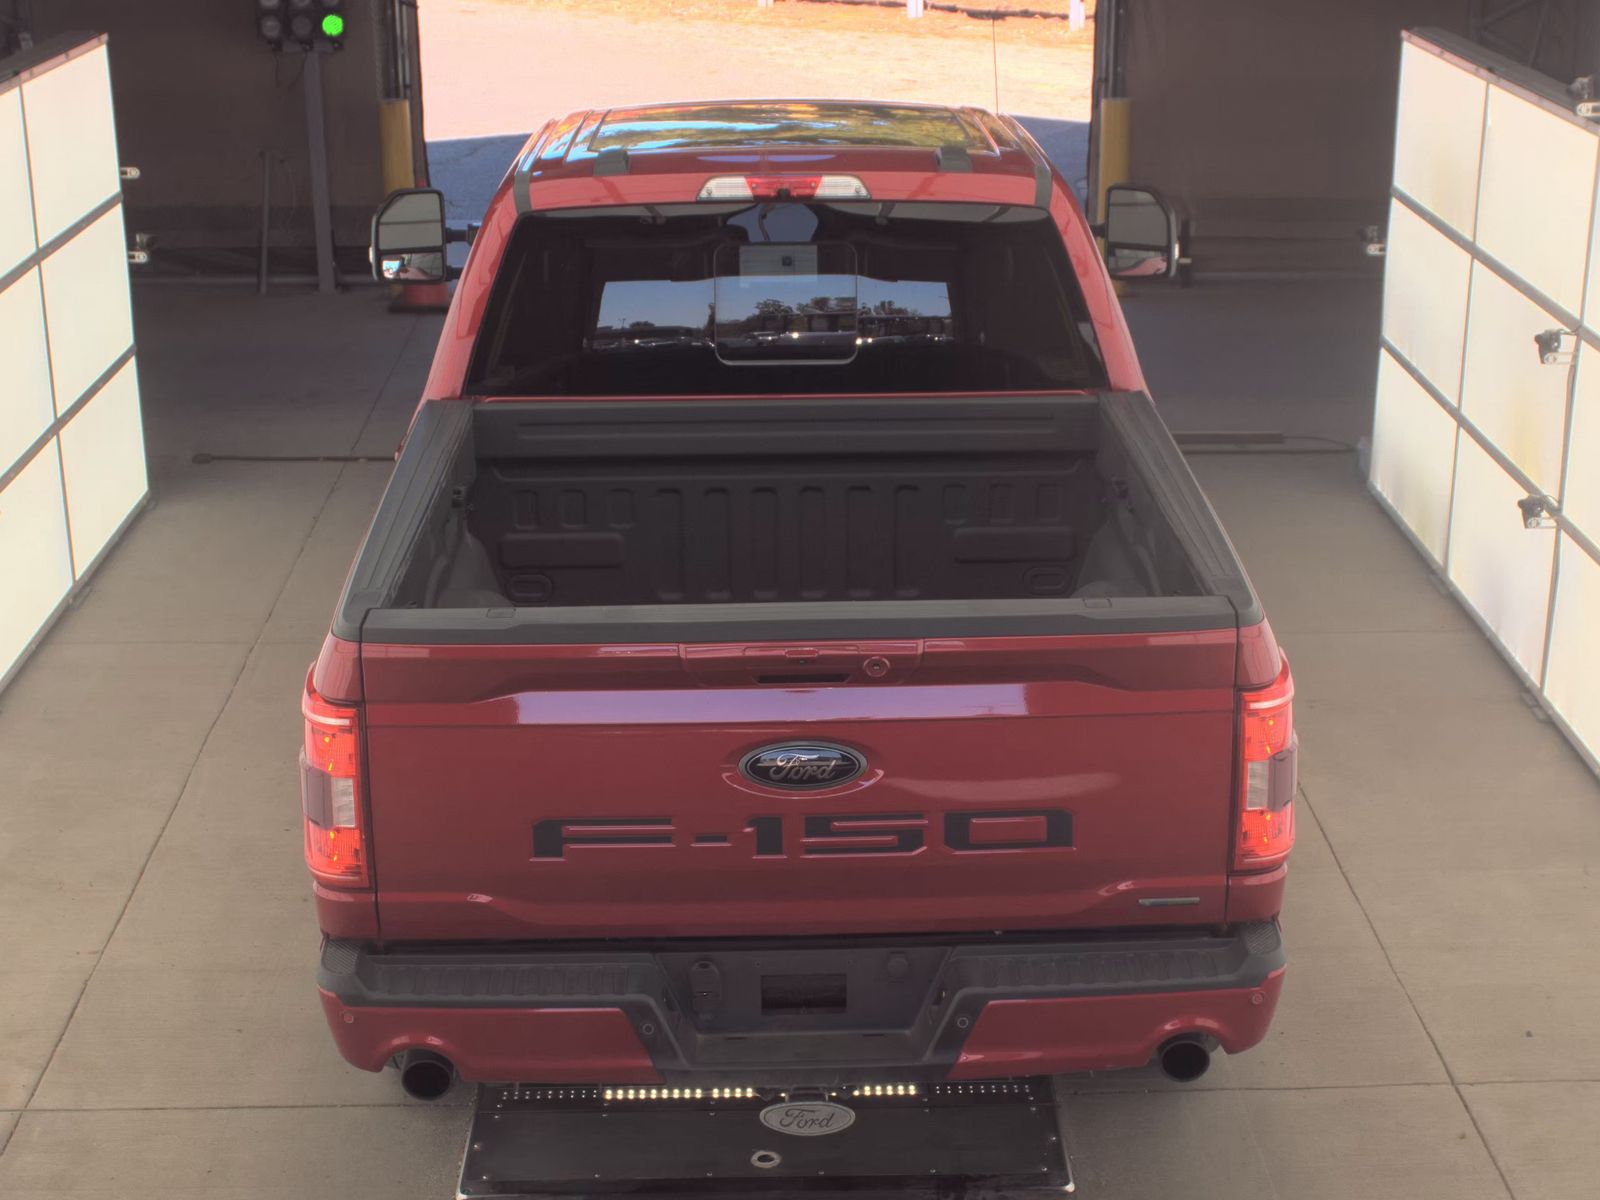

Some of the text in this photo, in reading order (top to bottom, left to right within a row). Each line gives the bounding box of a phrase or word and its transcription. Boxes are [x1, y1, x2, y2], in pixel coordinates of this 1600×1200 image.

[769, 752, 837, 780] Ford
[531, 808, 1075, 861] F-150
[779, 1107, 835, 1129] Ford
